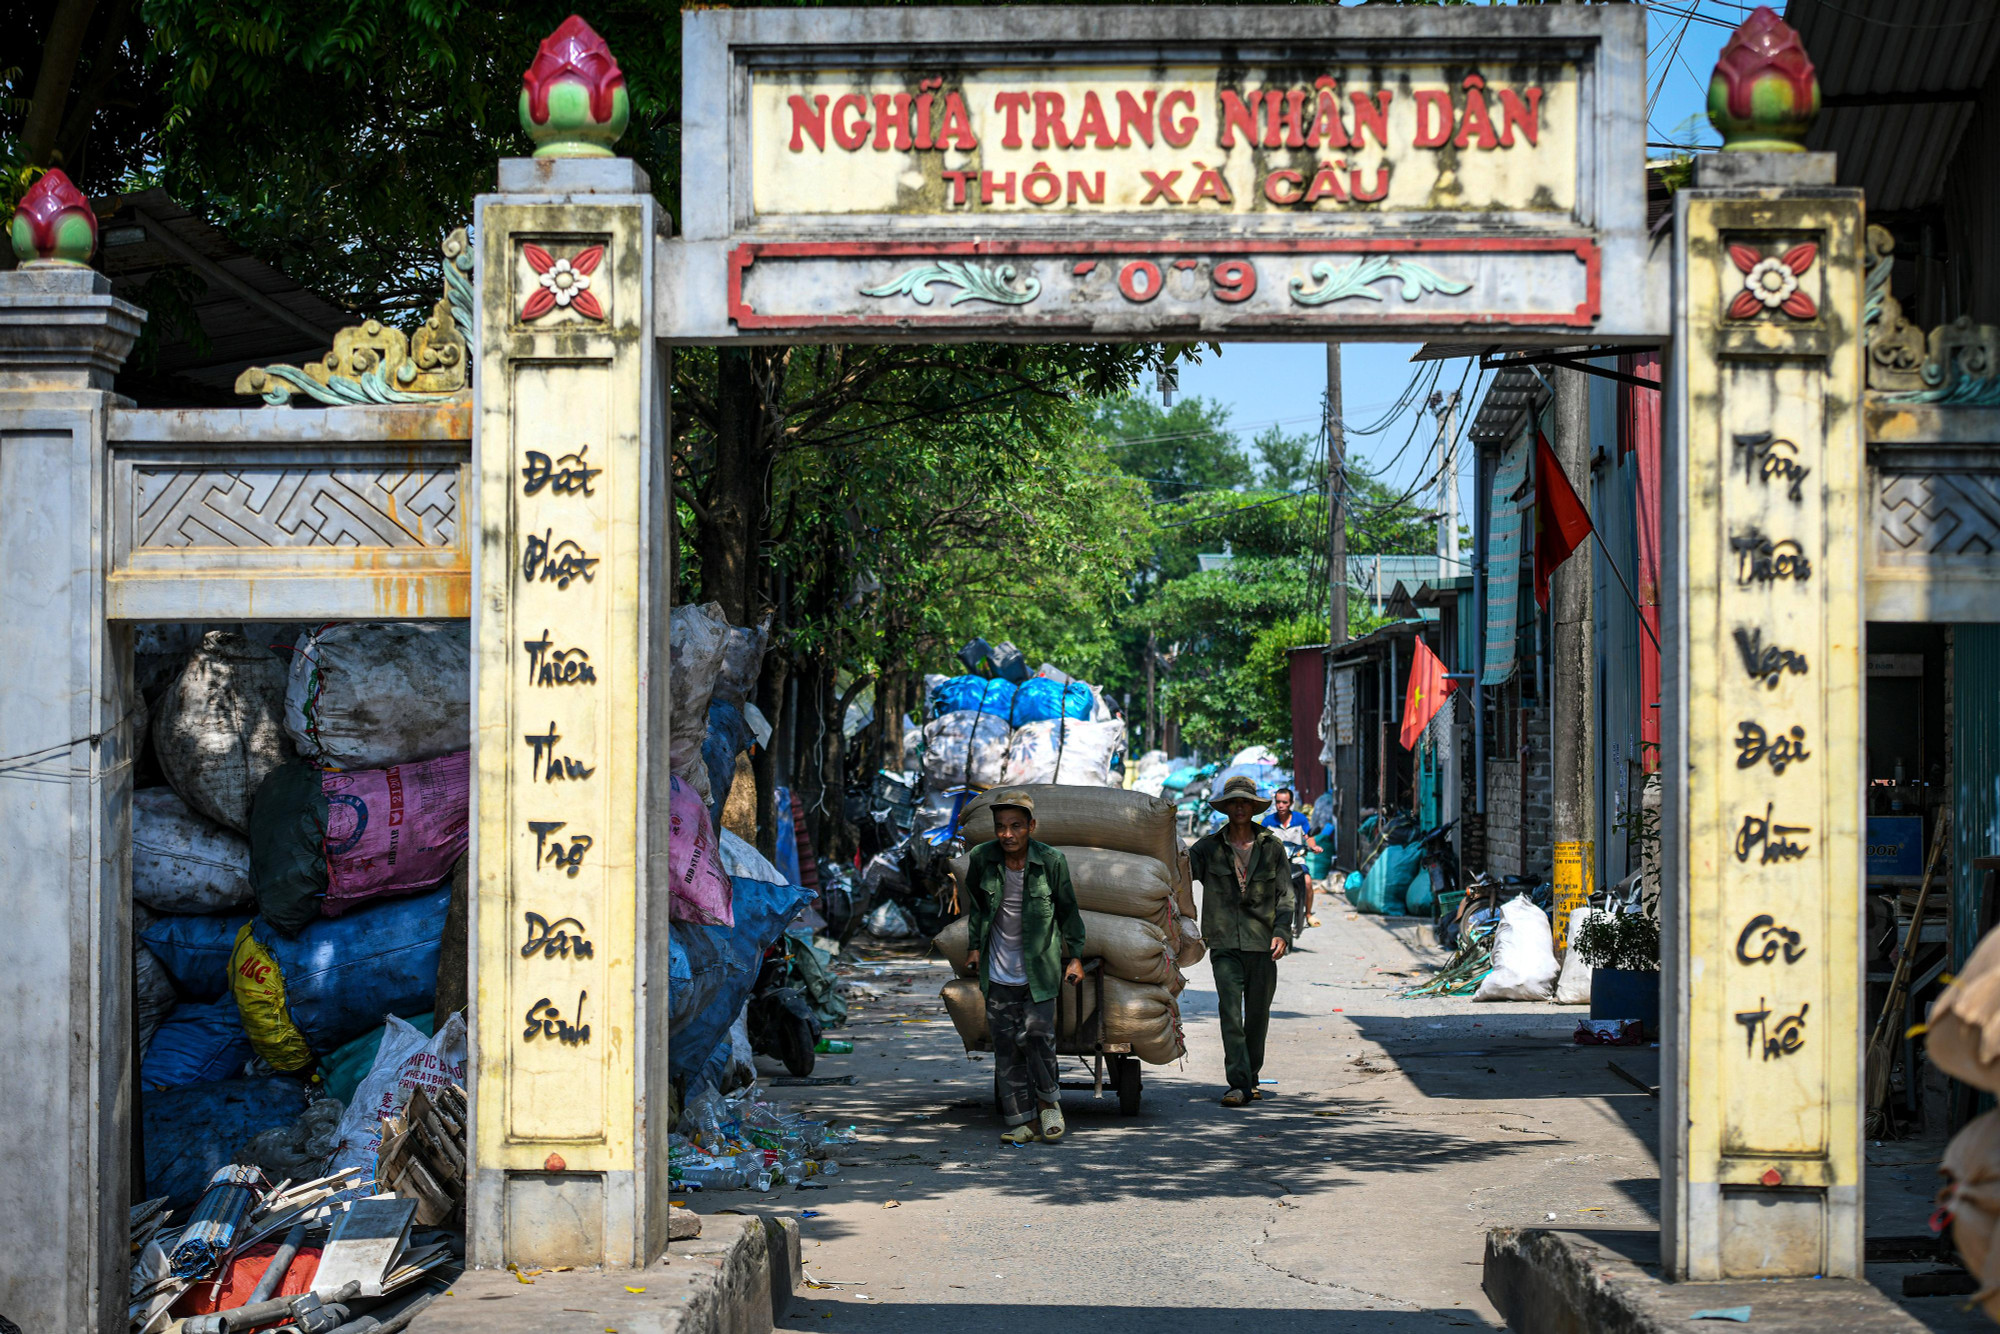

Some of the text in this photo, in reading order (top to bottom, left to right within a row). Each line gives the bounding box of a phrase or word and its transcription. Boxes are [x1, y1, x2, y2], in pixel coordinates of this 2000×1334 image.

[787, 73, 1543, 152] NGHĨA TRANG NHÂN DÂN
[941, 159, 1389, 205] THÔN XÀ CẦU
[1731, 430, 1811, 503] Tây
[1731, 626, 1809, 691] Vạn
[521, 444, 602, 1048] Đất Phật Thiên Thu Trợ Dân Sinh
[1734, 720, 1811, 777] Đại
[387, 828, 400, 866] RED STAR
[684, 848, 702, 884] RED STAR
[239, 956, 271, 984] ABC
[1734, 997, 1811, 1063] Thế
